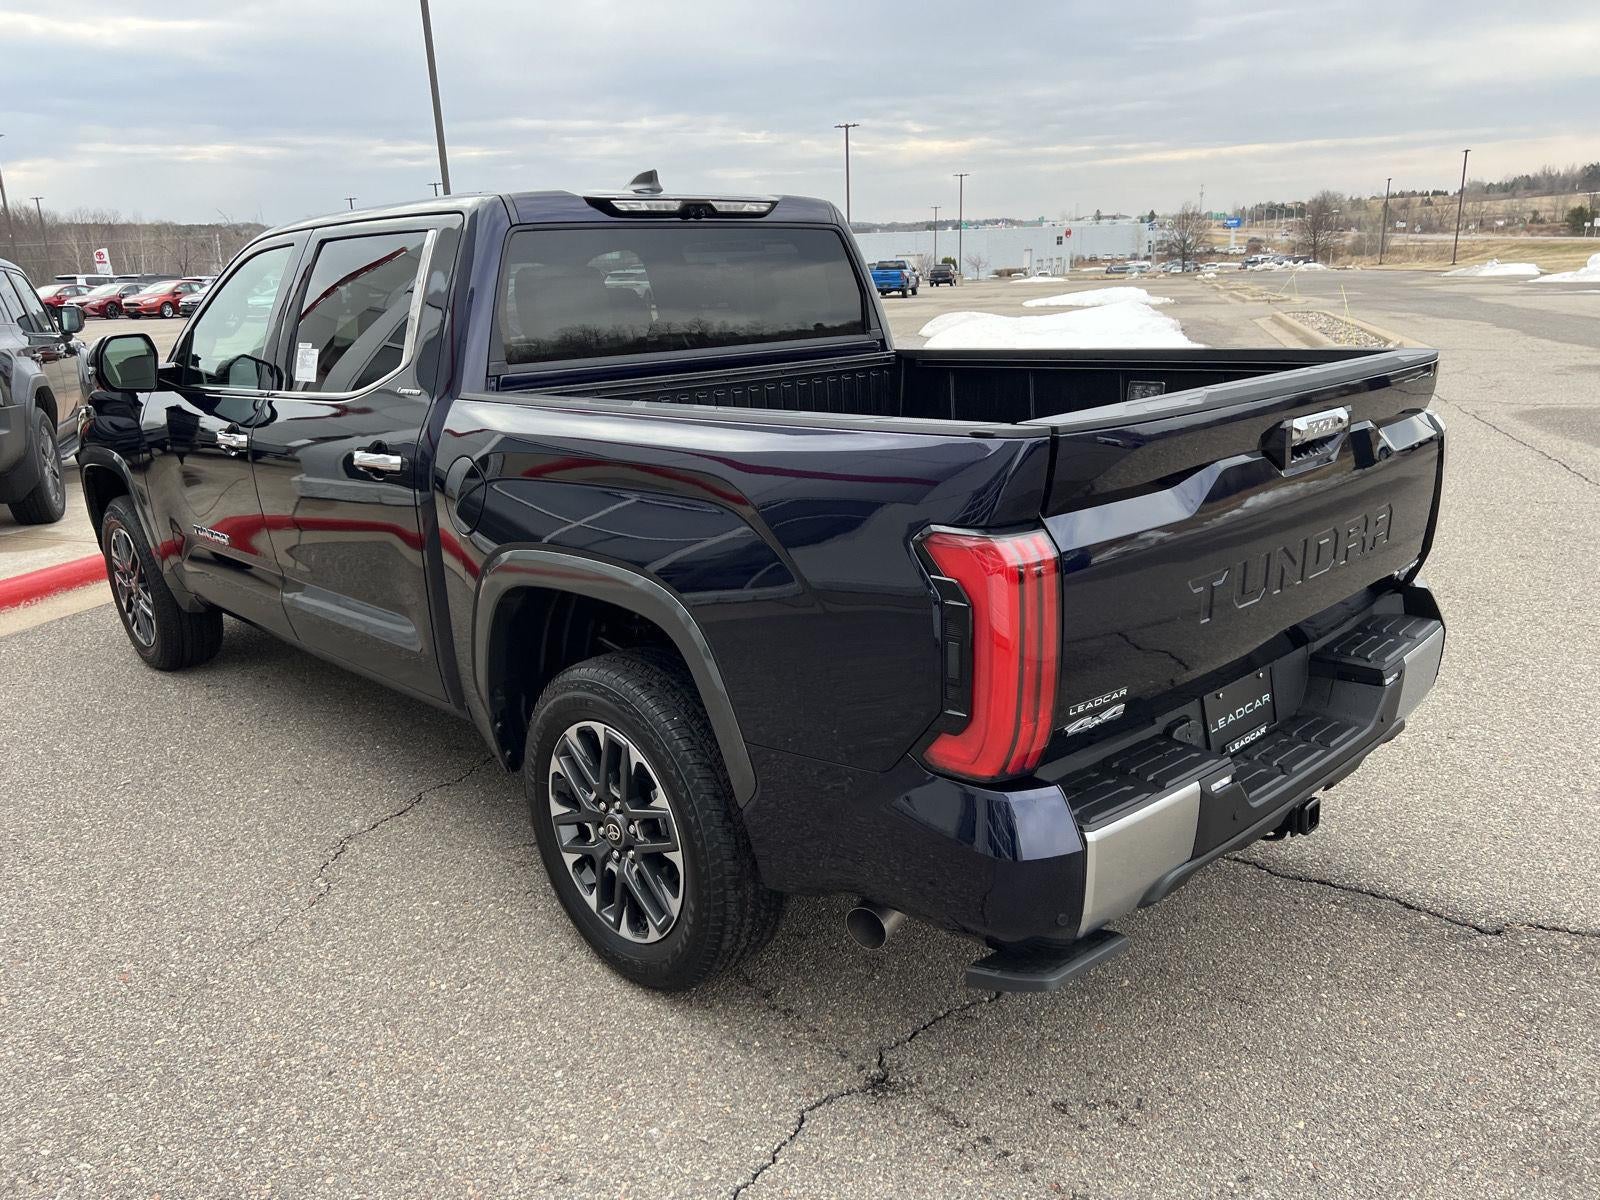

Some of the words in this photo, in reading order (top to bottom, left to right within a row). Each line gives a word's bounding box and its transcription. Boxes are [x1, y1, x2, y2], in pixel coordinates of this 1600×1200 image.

[1188, 503, 1393, 625] TUNDRA
[1069, 688, 1128, 716] LEADCAR
[1210, 693, 1271, 733] LEADCAR
[1229, 726, 1267, 752] LEADCAR
